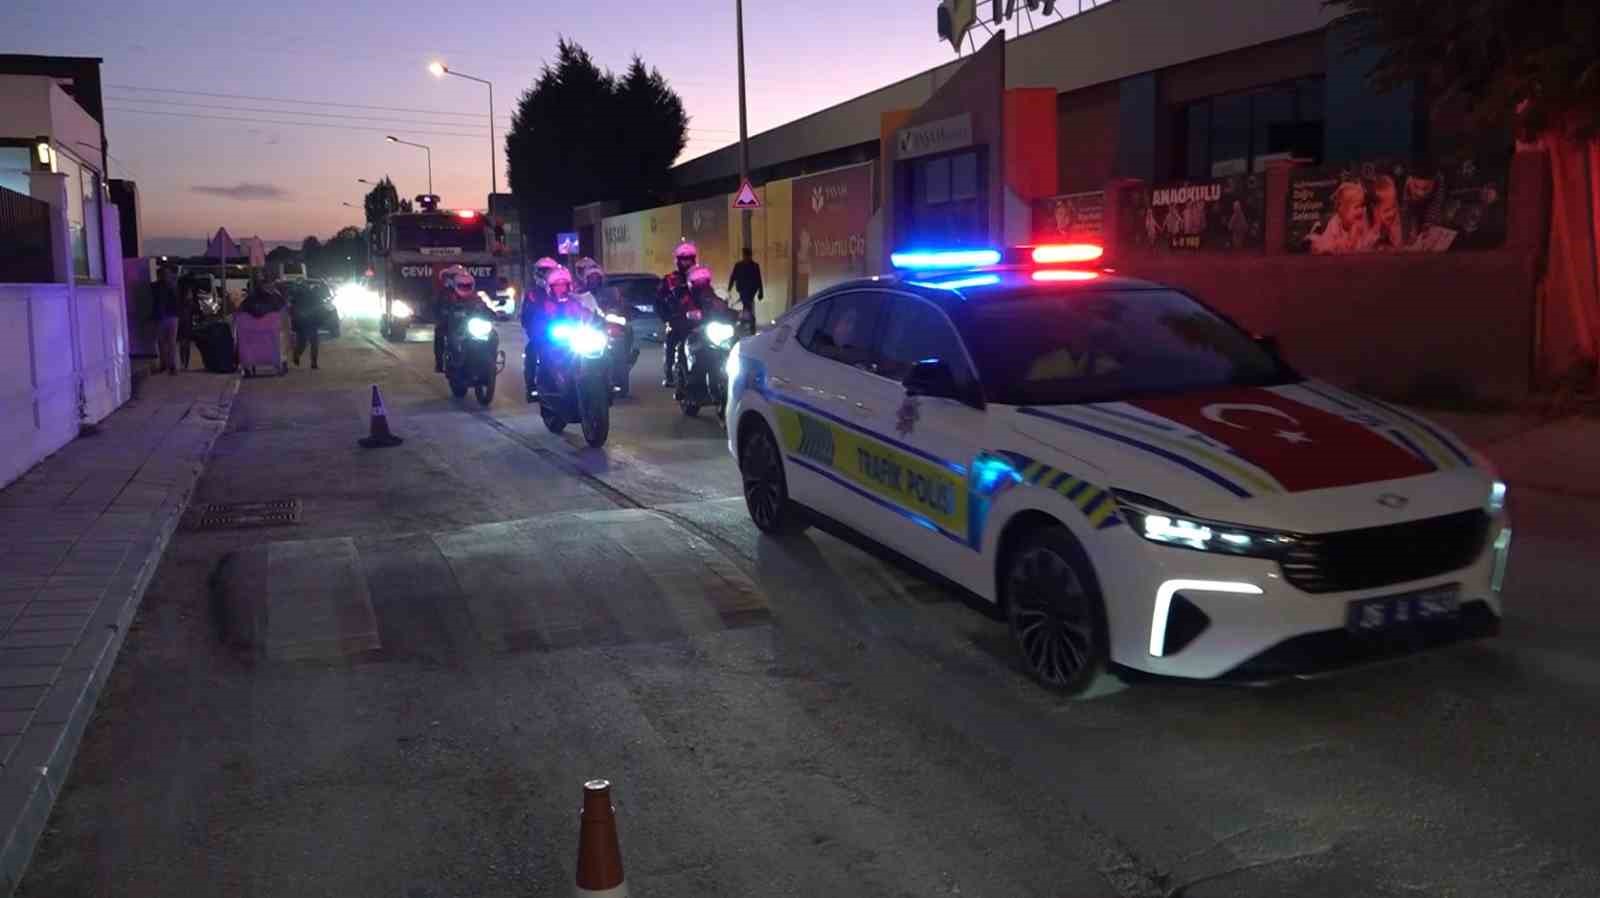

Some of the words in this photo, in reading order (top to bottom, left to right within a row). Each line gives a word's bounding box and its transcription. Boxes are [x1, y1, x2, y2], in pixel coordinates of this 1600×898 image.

[1152, 184, 1221, 206] ANAOKULU
[401, 263, 433, 279] ÇEVİ
[857, 446, 902, 493] TRAFİK
[906, 466, 957, 516] POLİS
